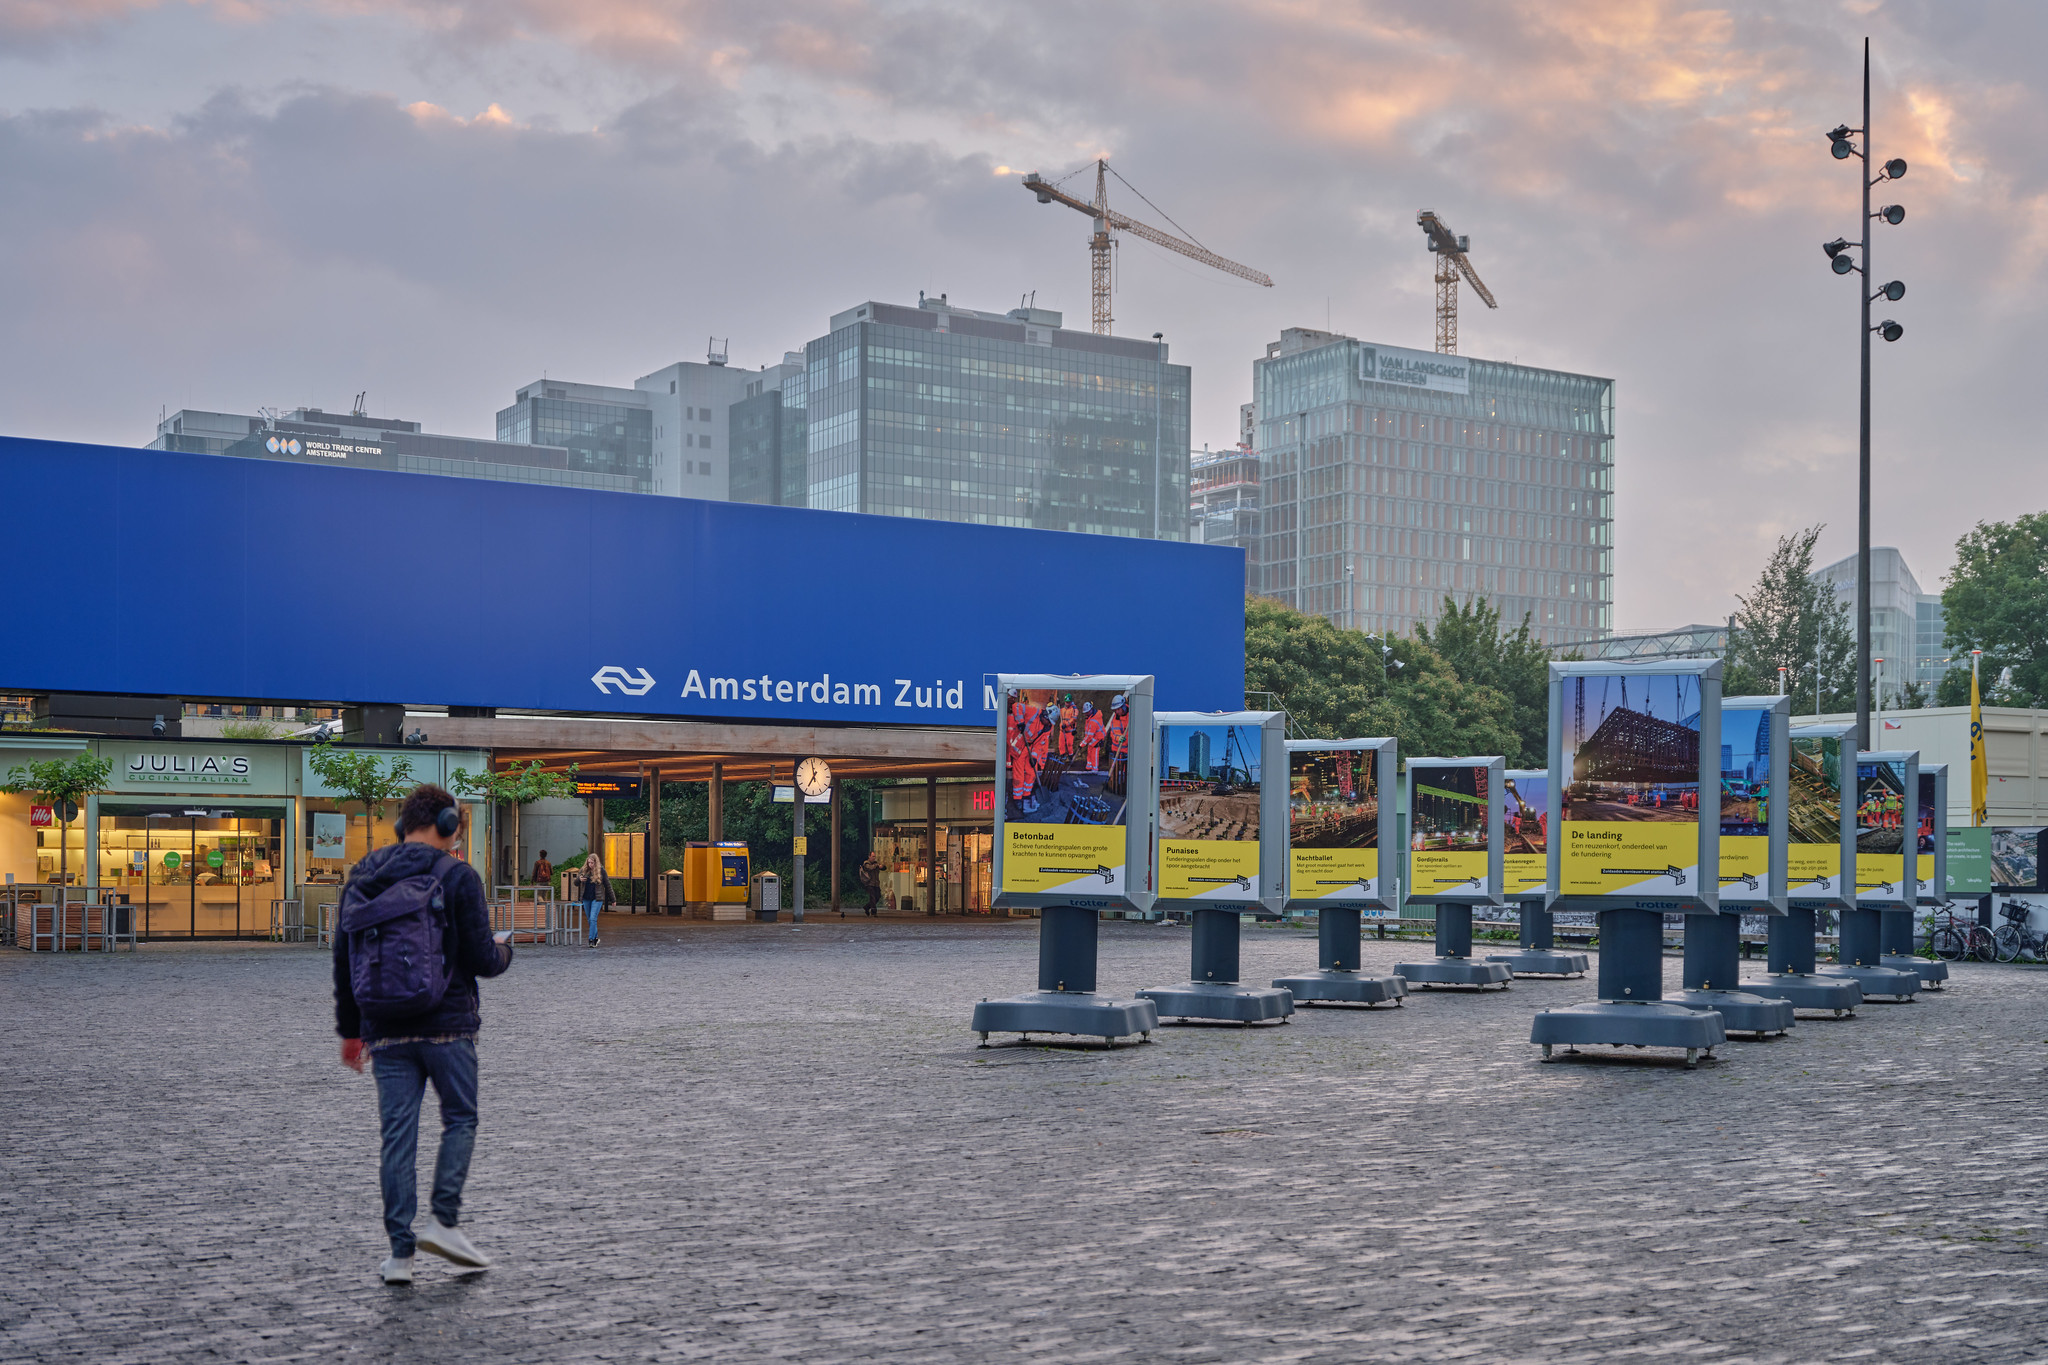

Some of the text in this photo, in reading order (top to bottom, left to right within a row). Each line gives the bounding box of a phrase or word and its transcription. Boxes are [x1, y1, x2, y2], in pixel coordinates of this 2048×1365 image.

[1380, 356, 1466, 378] VAN LANSCHOT
[1380, 368, 1427, 385] KEMPEN
[306, 441, 382, 455] WORLD TRADE CENTER
[306, 450, 347, 458] AMSTERDAM
[680, 669, 881, 706] Amsterdam
[894, 679, 964, 709] Zuid
[130, 755, 248, 774] JULIA'S
[32, 808, 50, 824] illy
[1013, 832, 1054, 840] Betonbad
[1572, 831, 1622, 841] De landing
